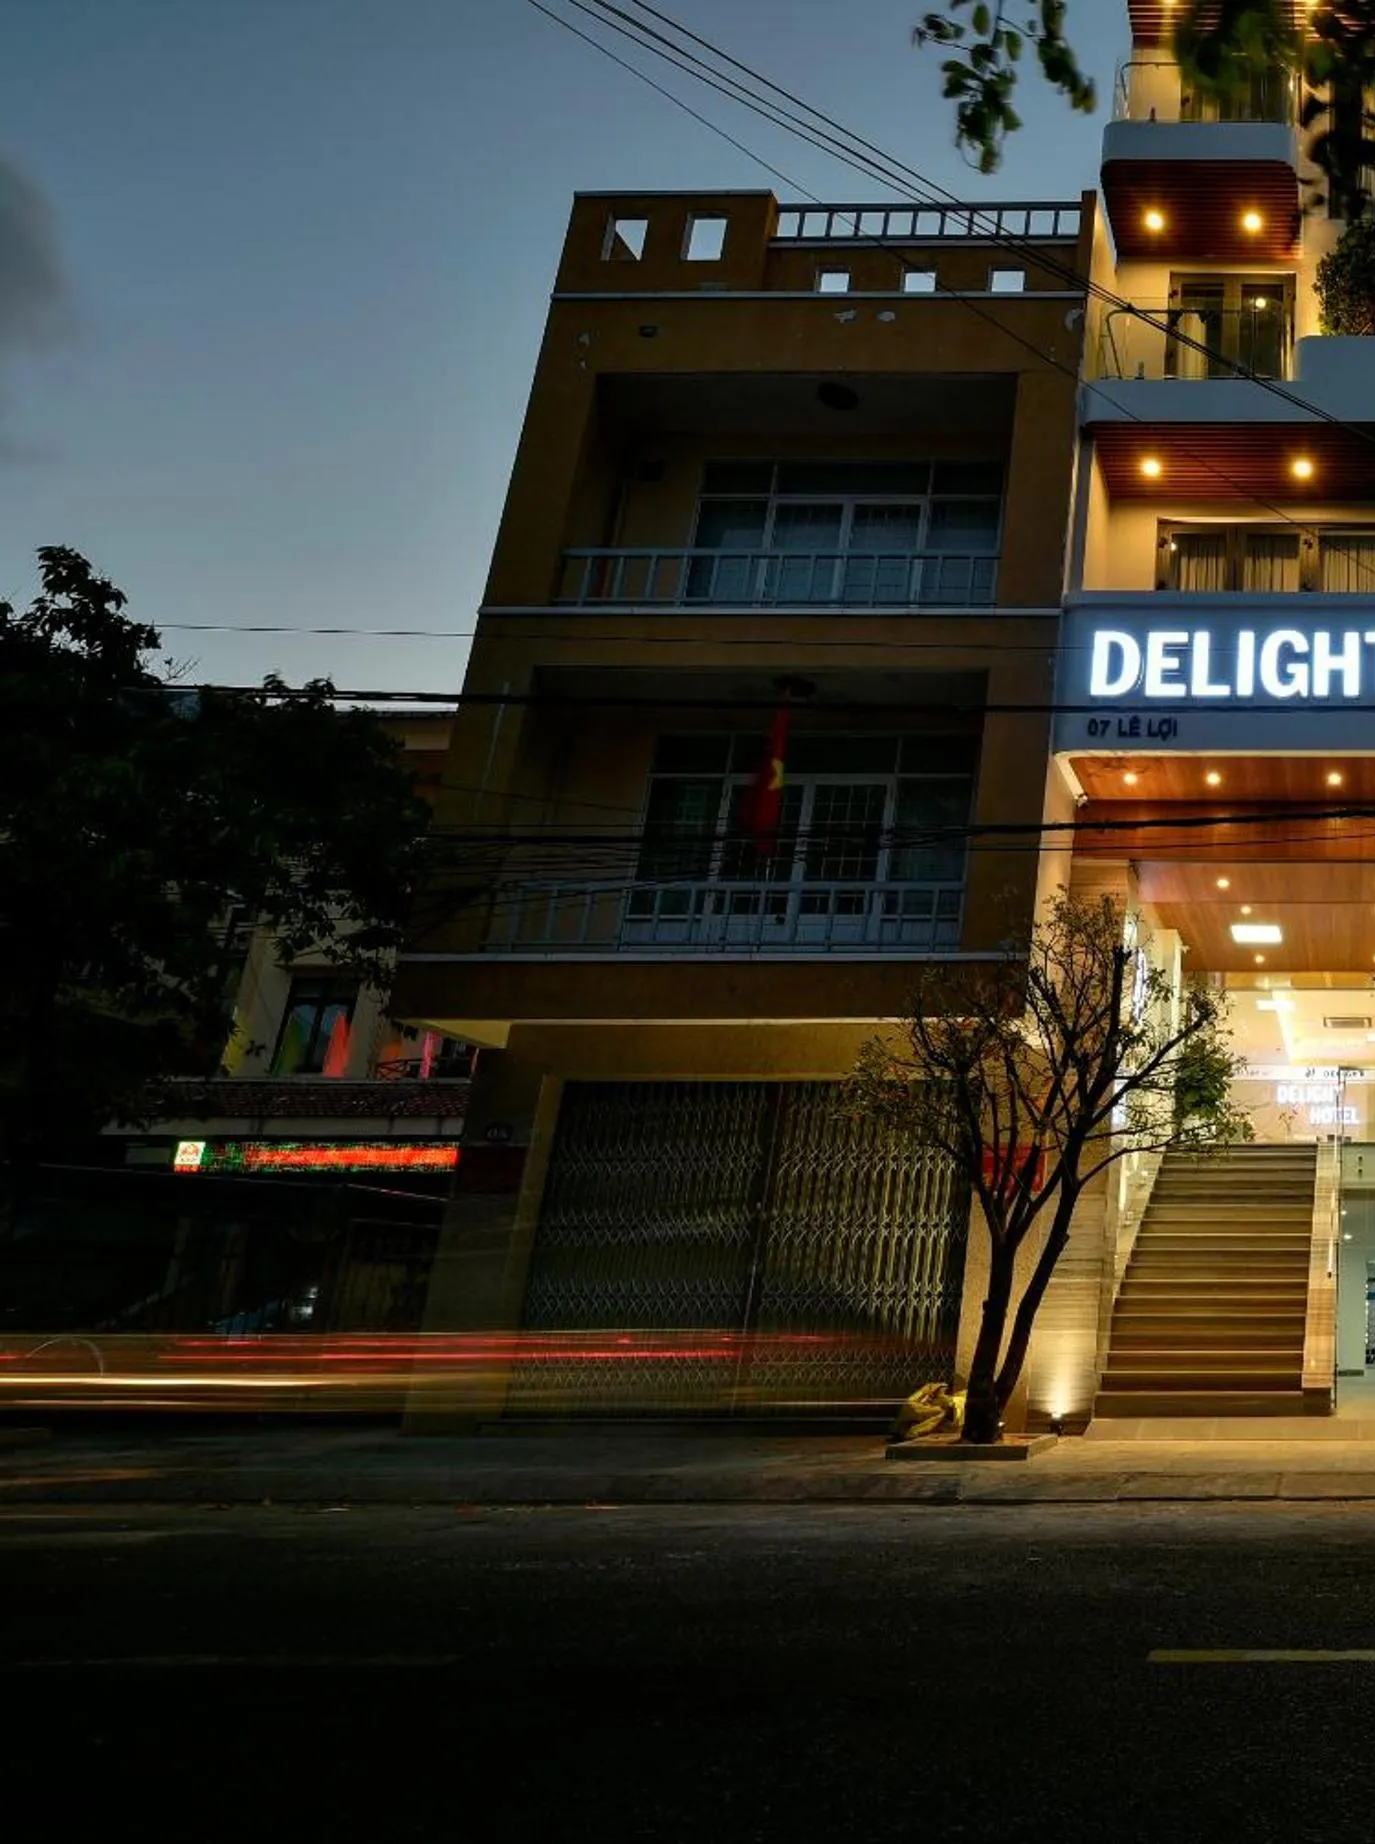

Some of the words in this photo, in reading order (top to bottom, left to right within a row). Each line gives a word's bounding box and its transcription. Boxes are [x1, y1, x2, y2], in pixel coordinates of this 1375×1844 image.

[1087, 718, 1111, 738] 07
[1118, 715, 1141, 738] LÊ
[1147, 716, 1178, 742] LỢI
